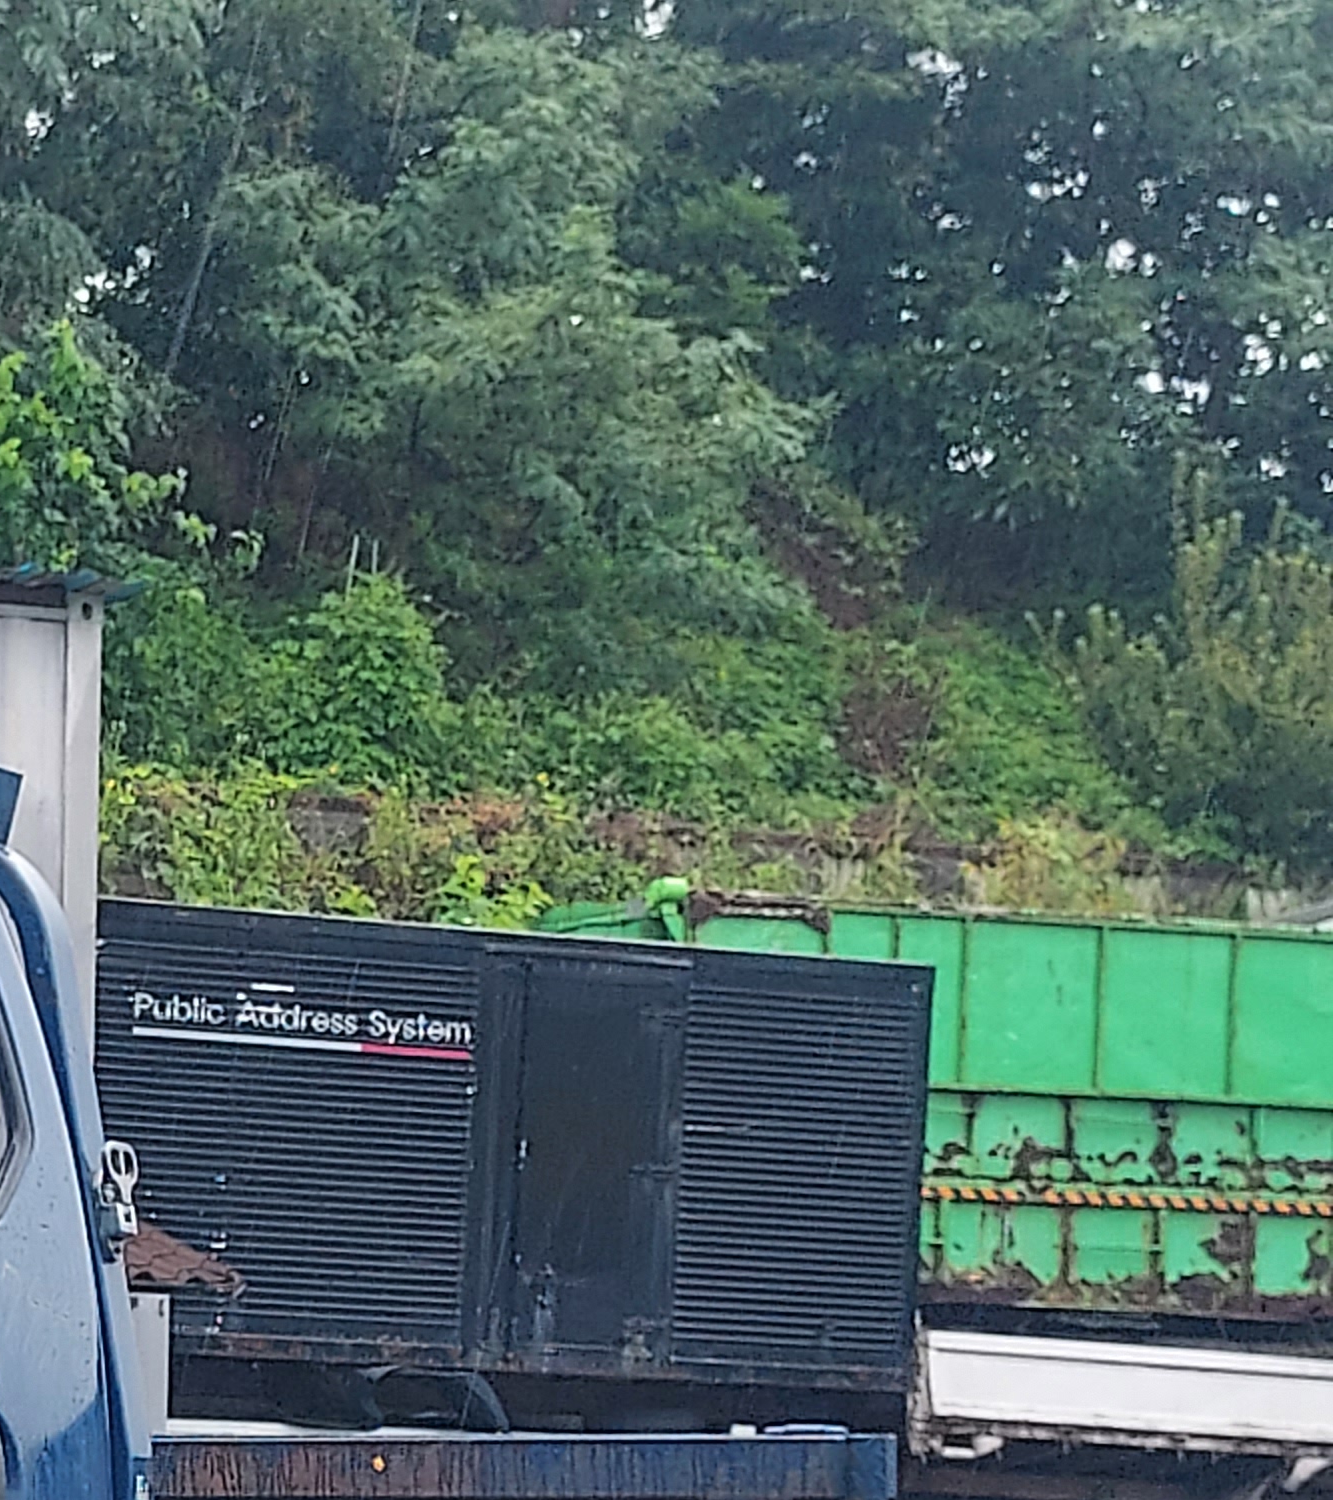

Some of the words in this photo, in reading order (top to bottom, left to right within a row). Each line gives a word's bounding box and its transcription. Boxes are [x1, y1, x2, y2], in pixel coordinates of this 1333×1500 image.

[133, 991, 226, 1026] Public
[234, 998, 358, 1035] Address
[368, 1009, 472, 1044] System
